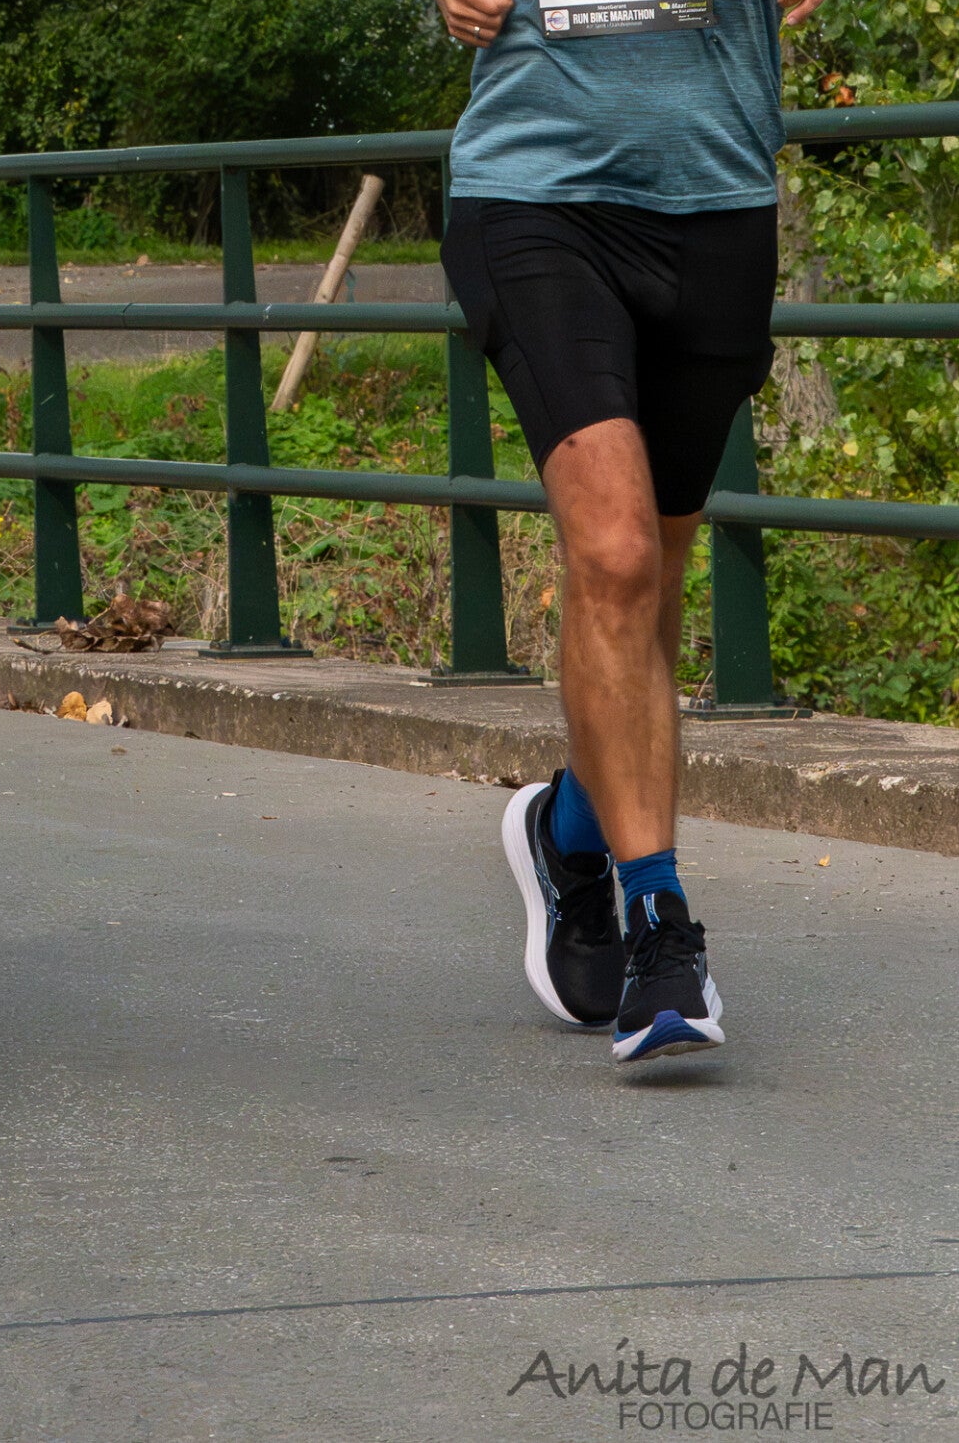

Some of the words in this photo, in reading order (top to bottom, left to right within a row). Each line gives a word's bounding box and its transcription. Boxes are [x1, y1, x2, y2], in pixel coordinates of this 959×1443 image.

[572, 12, 589, 25] RUN
[590, 10, 609, 23] BIKE
[610, 8, 655, 22] MARATHON
